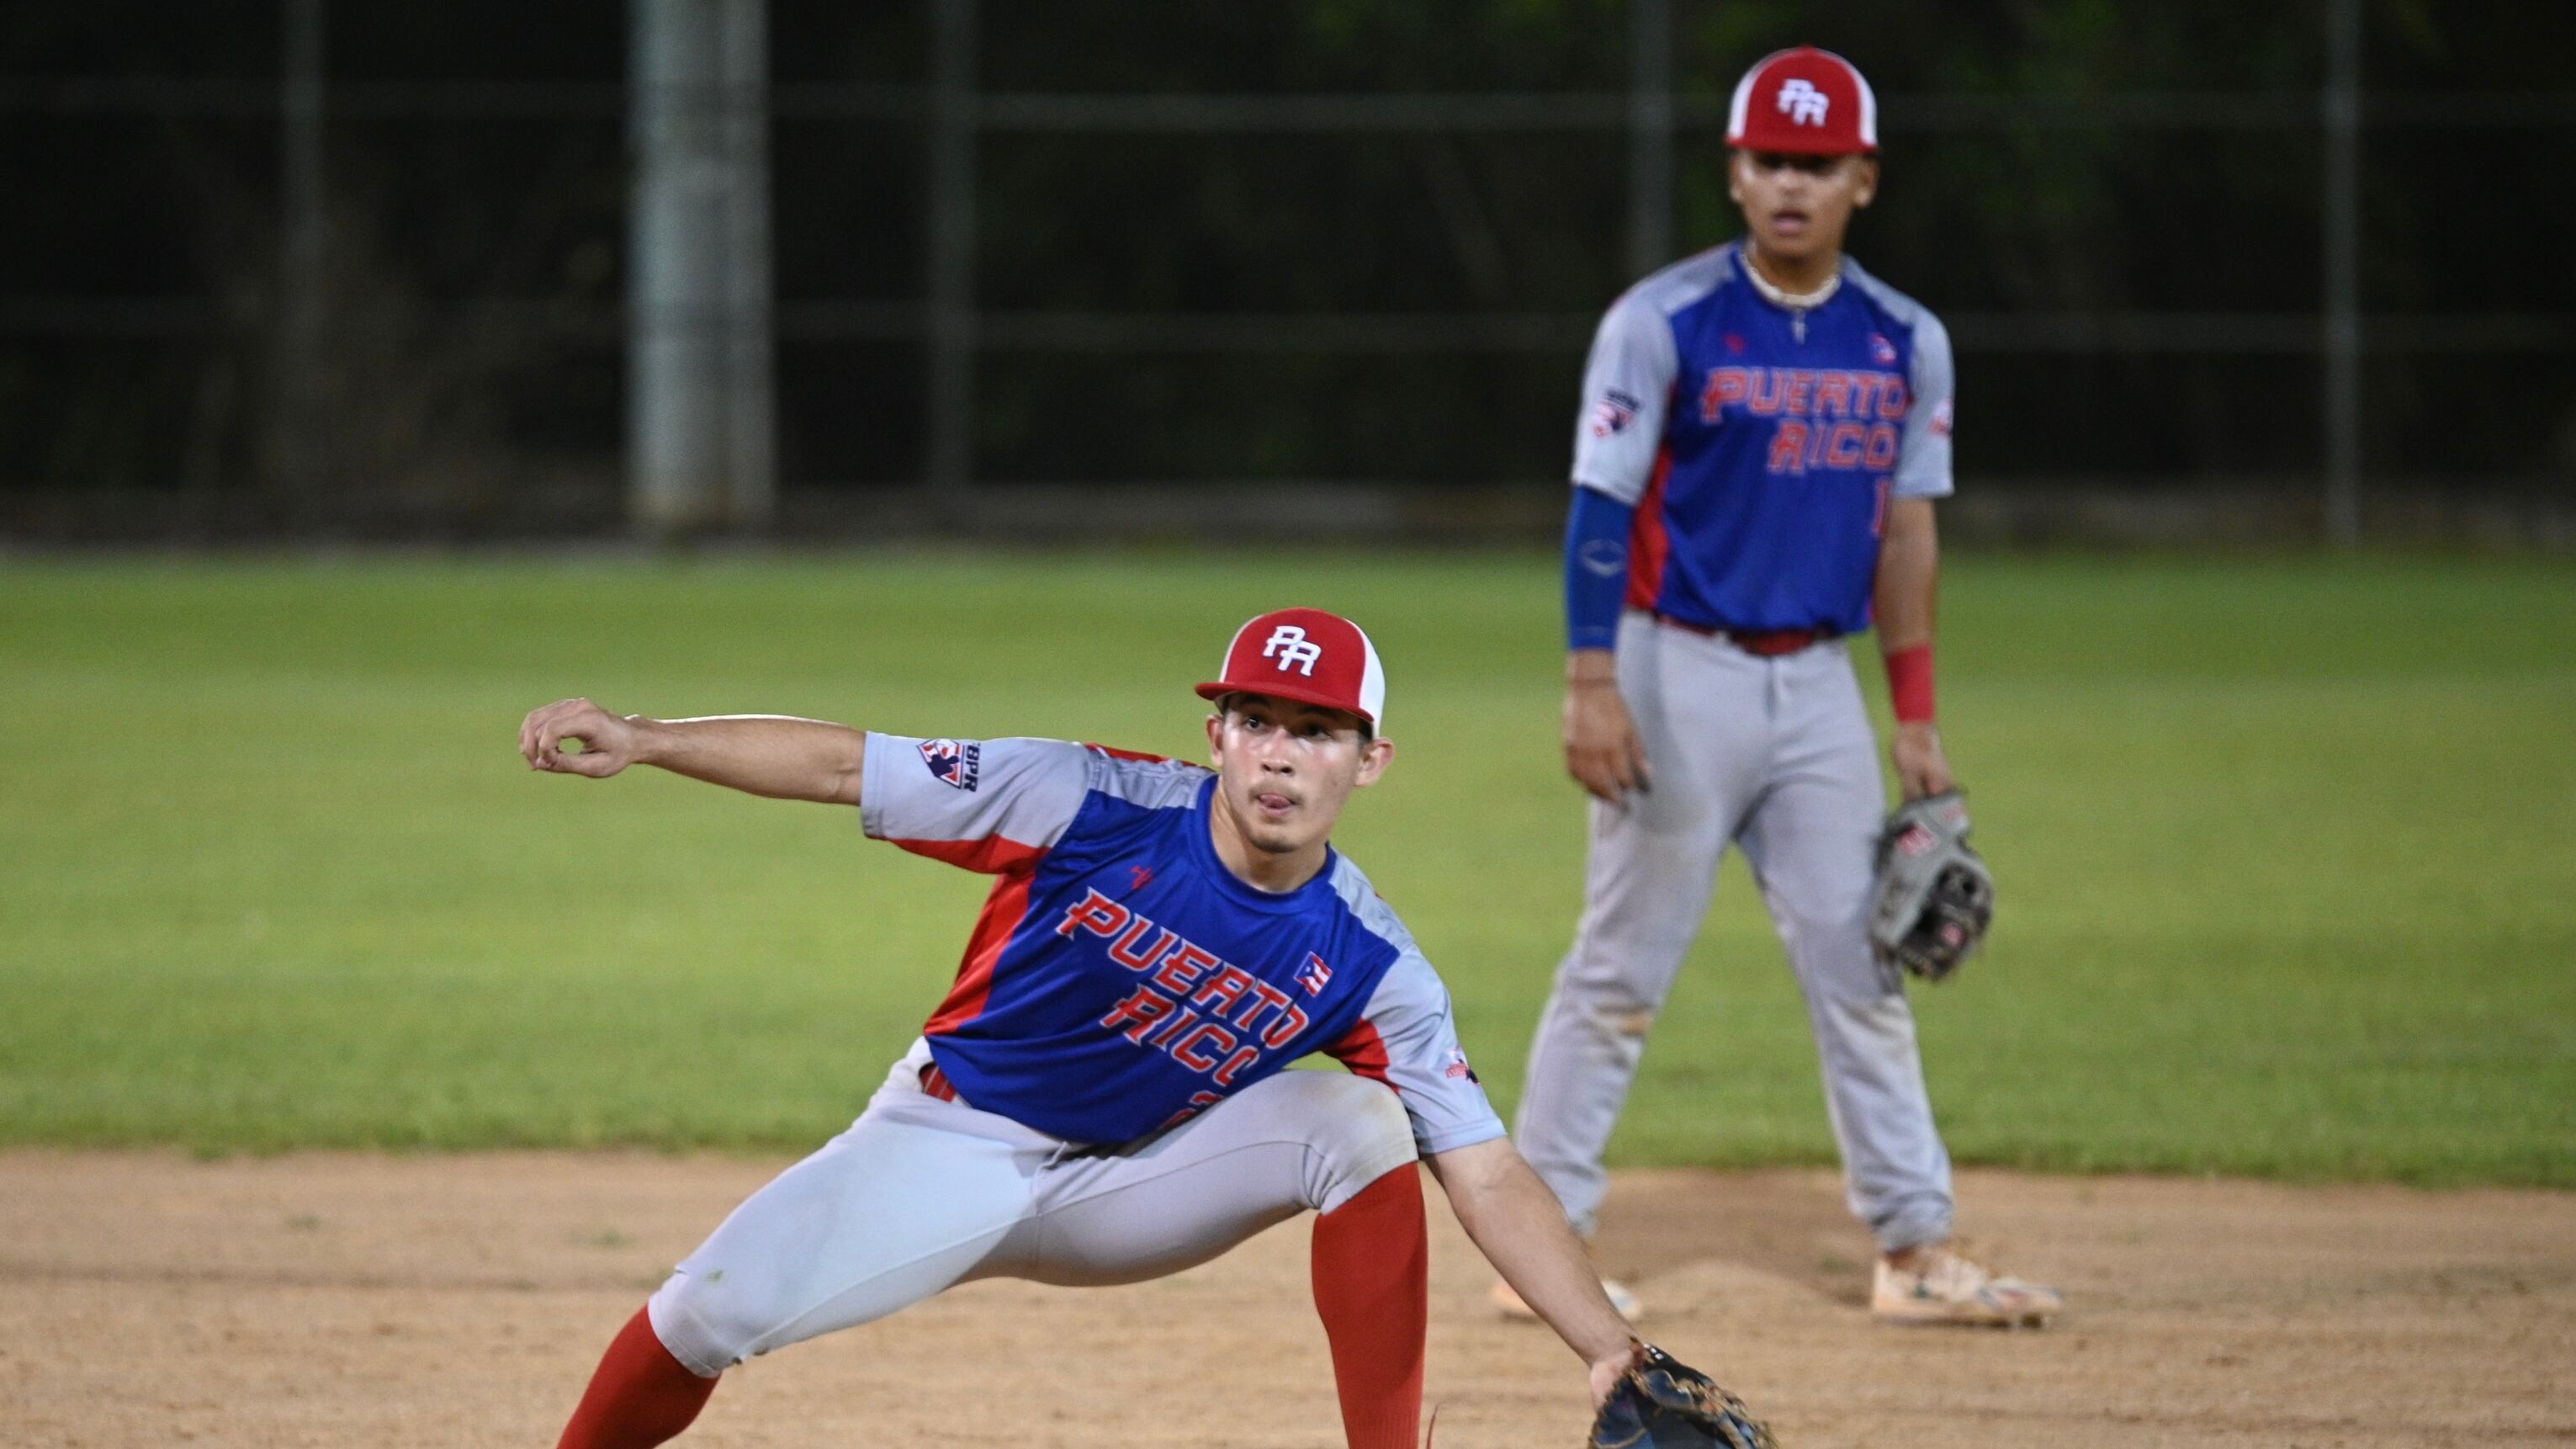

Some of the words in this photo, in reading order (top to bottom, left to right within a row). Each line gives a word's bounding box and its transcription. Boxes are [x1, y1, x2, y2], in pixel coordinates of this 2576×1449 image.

[1777, 78, 1830, 126] PR
[1701, 367, 1908, 425] PUERTO
[1768, 418, 1896, 475] RICO
[1262, 625, 1322, 677] PR
[964, 742, 981, 793] BPR
[1056, 886, 1310, 1050] PUERTO
